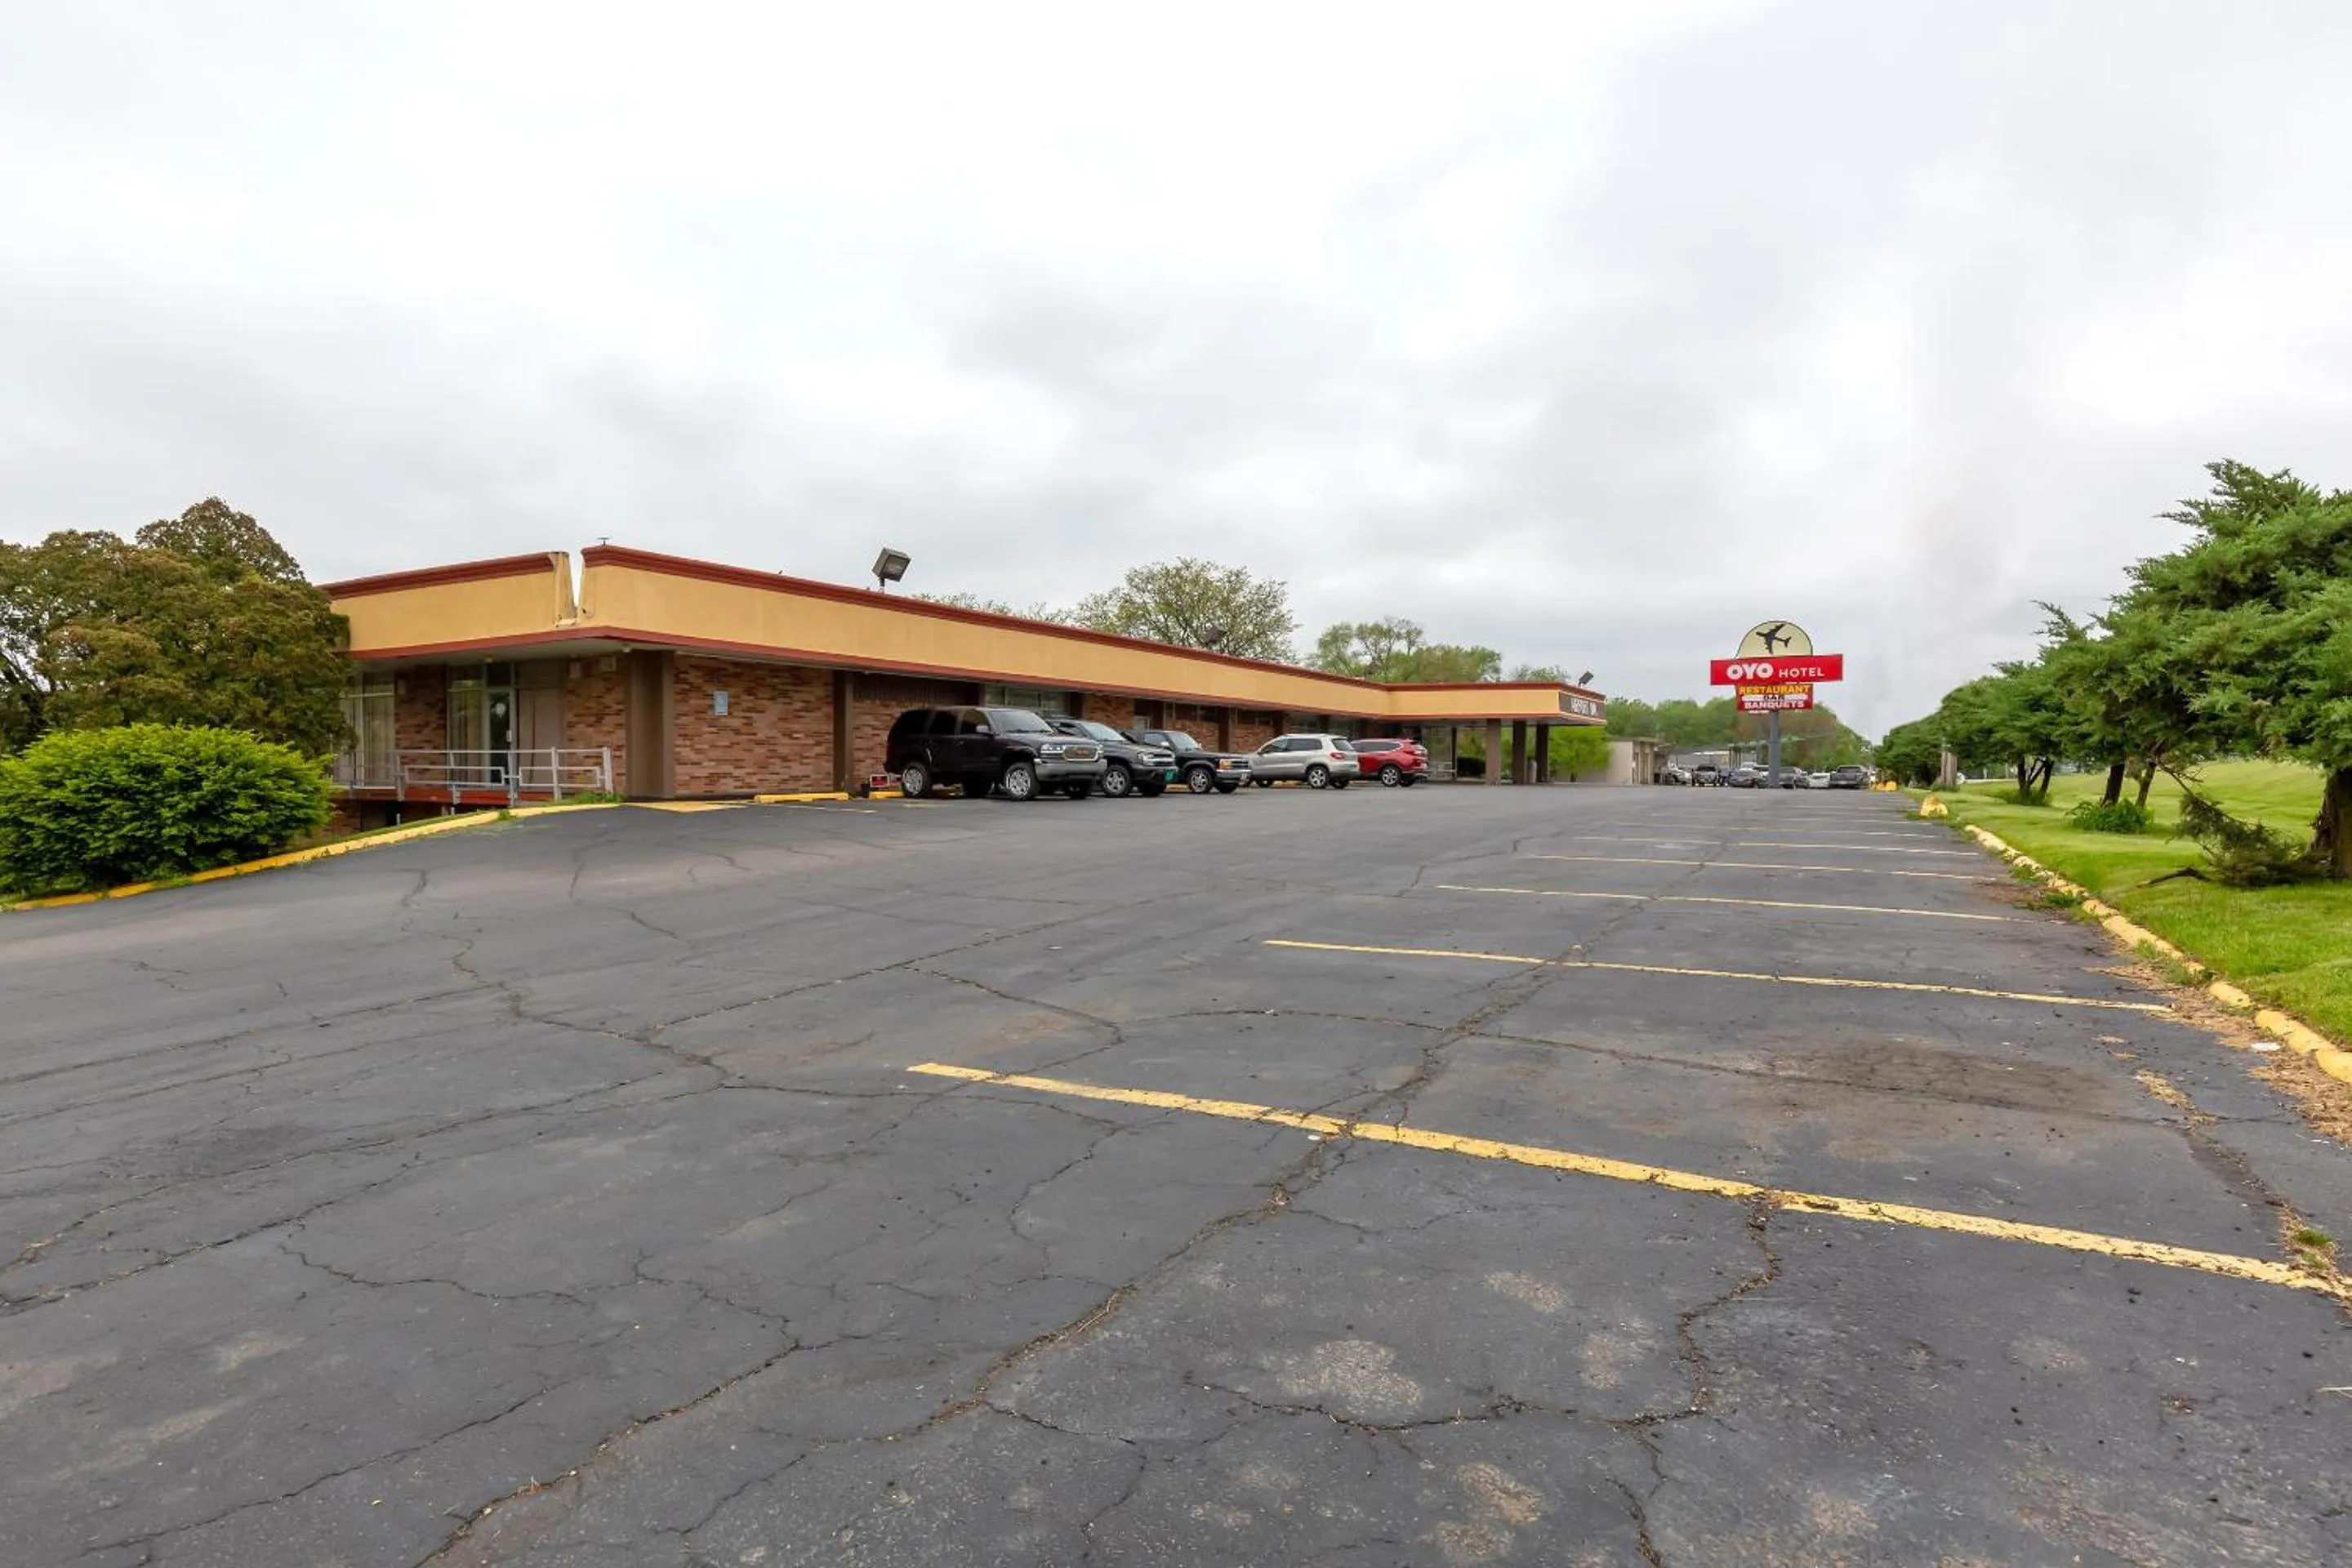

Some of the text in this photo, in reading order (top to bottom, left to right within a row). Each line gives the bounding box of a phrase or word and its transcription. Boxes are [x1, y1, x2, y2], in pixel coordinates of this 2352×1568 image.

[1726, 662, 1825, 679] OYO HOTEL
[1740, 684, 1810, 695] RESTAURANT
[1744, 700, 1805, 710] BANQUETS
